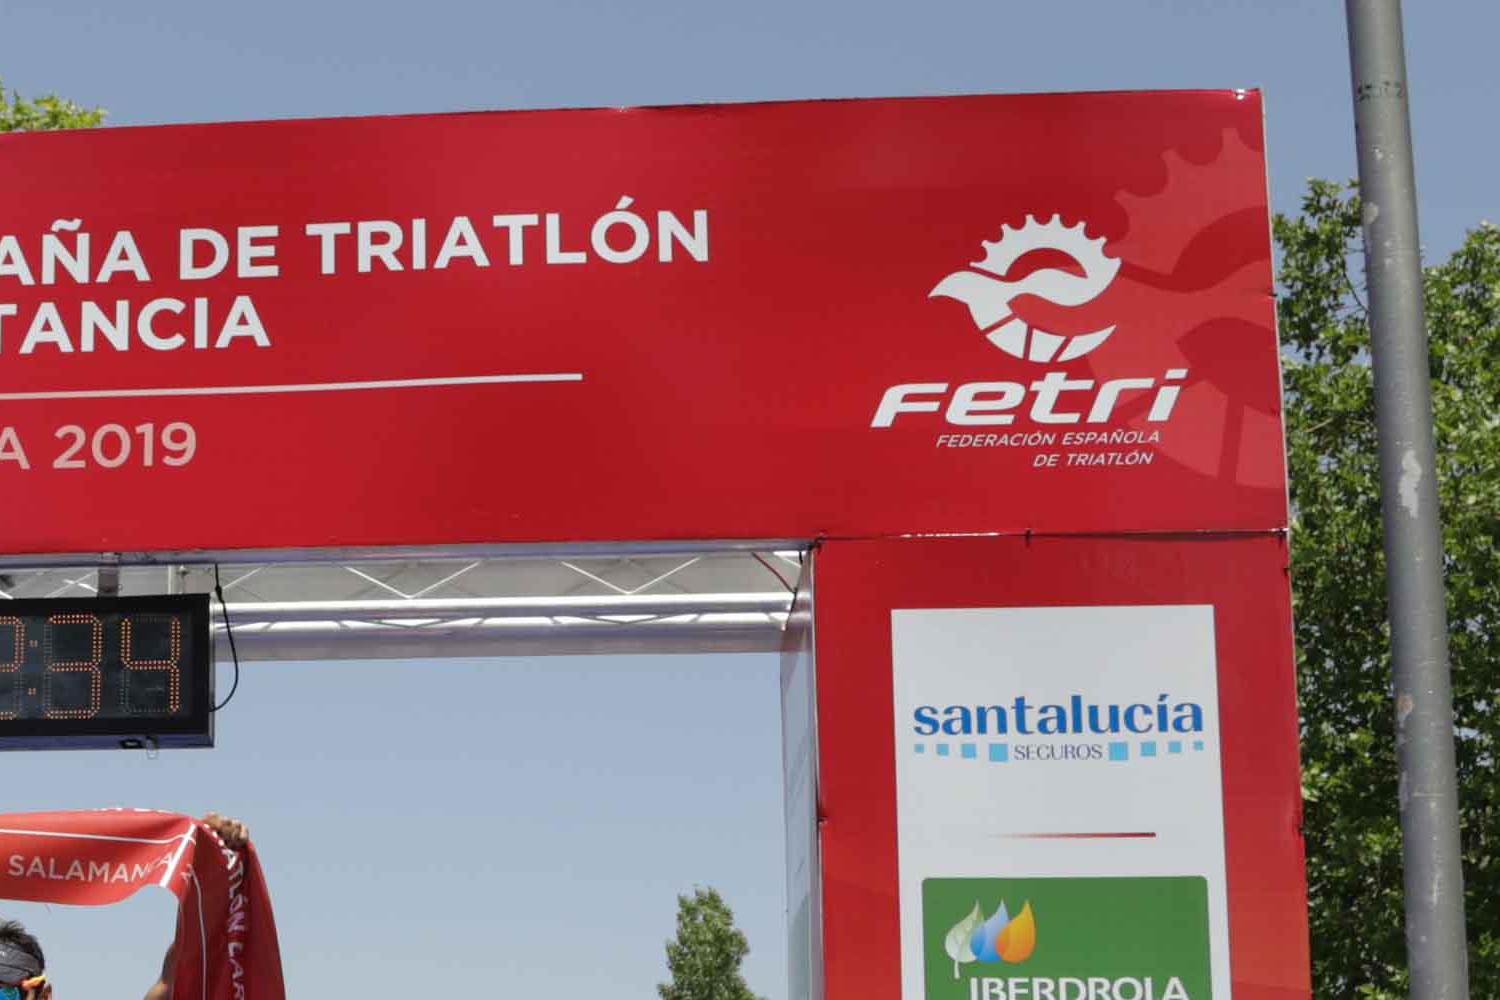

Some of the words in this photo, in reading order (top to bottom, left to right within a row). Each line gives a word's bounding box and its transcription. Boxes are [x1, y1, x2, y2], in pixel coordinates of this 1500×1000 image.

[179, 225, 279, 280] DE
[306, 195, 709, 275] TRIATLÓN
[53, 421, 197, 469] 2019
[936, 431, 1055, 448] FEDERACIÓN
[1062, 429, 1160, 445] ESPAÑOLA
[1033, 454, 1057, 467] DE
[1067, 450, 1153, 466] TRIATLÓN
[913, 694, 1204, 735] santalucía
[1014, 744, 1102, 760] SEGUROS
